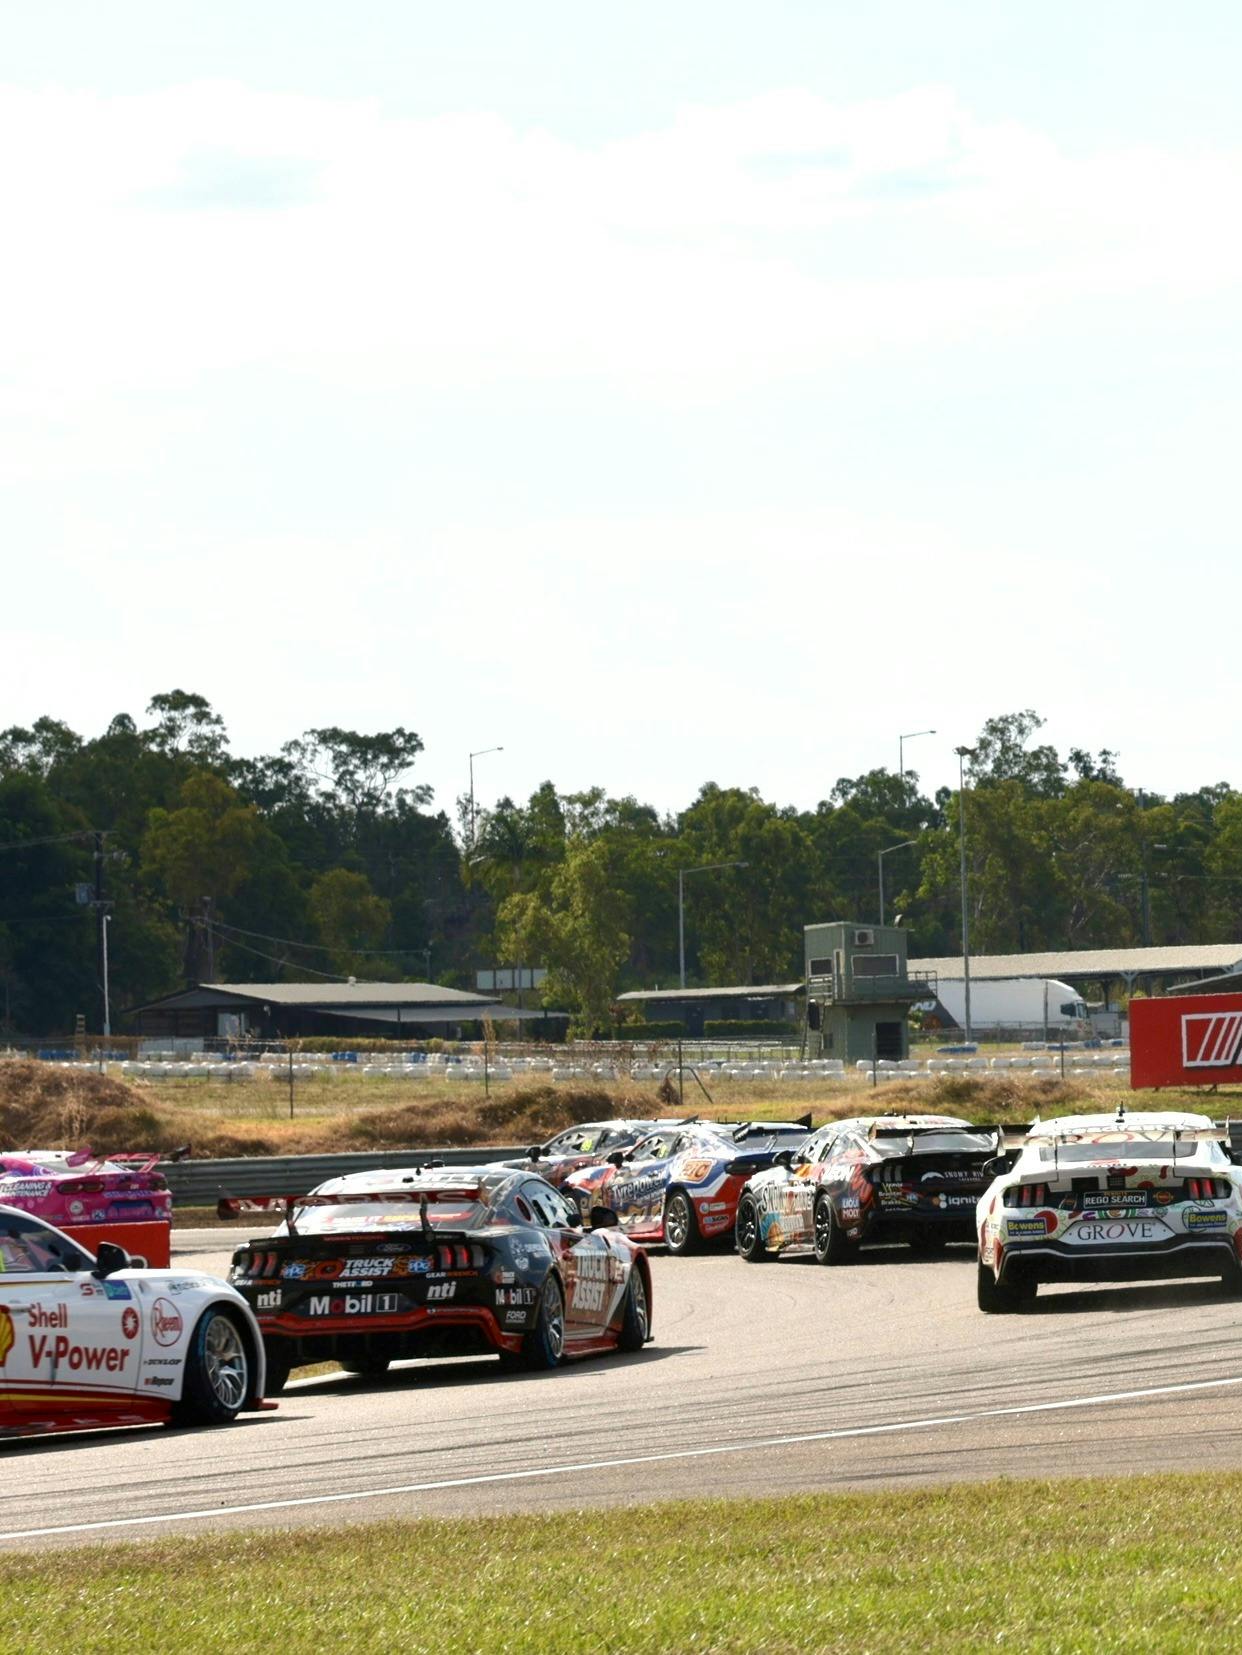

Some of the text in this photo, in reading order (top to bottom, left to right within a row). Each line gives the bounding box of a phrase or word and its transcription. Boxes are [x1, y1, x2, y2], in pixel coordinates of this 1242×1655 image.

[611, 1168, 667, 1207] Tyrepower
[1085, 1196, 1109, 1205] REGO
[1111, 1195, 1145, 1204] SEARCH
[843, 1209, 859, 1220] MOLY
[1189, 1213, 1226, 1223] Bowens
[1007, 1221, 1045, 1230] Bowens
[1077, 1222, 1153, 1241] GROVE
[346, 1258, 395, 1268] TRUCK
[339, 1267, 391, 1278] ASSIST
[257, 1289, 282, 1306] nti
[427, 1281, 456, 1298] nti
[496, 1288, 522, 1306] Mobil
[572, 1279, 606, 1311] ASSIST
[310, 1294, 371, 1315] Mobil
[28, 1302, 68, 1328] Shell
[505, 1310, 526, 1319] FORD
[28, 1334, 130, 1372] V-Power
